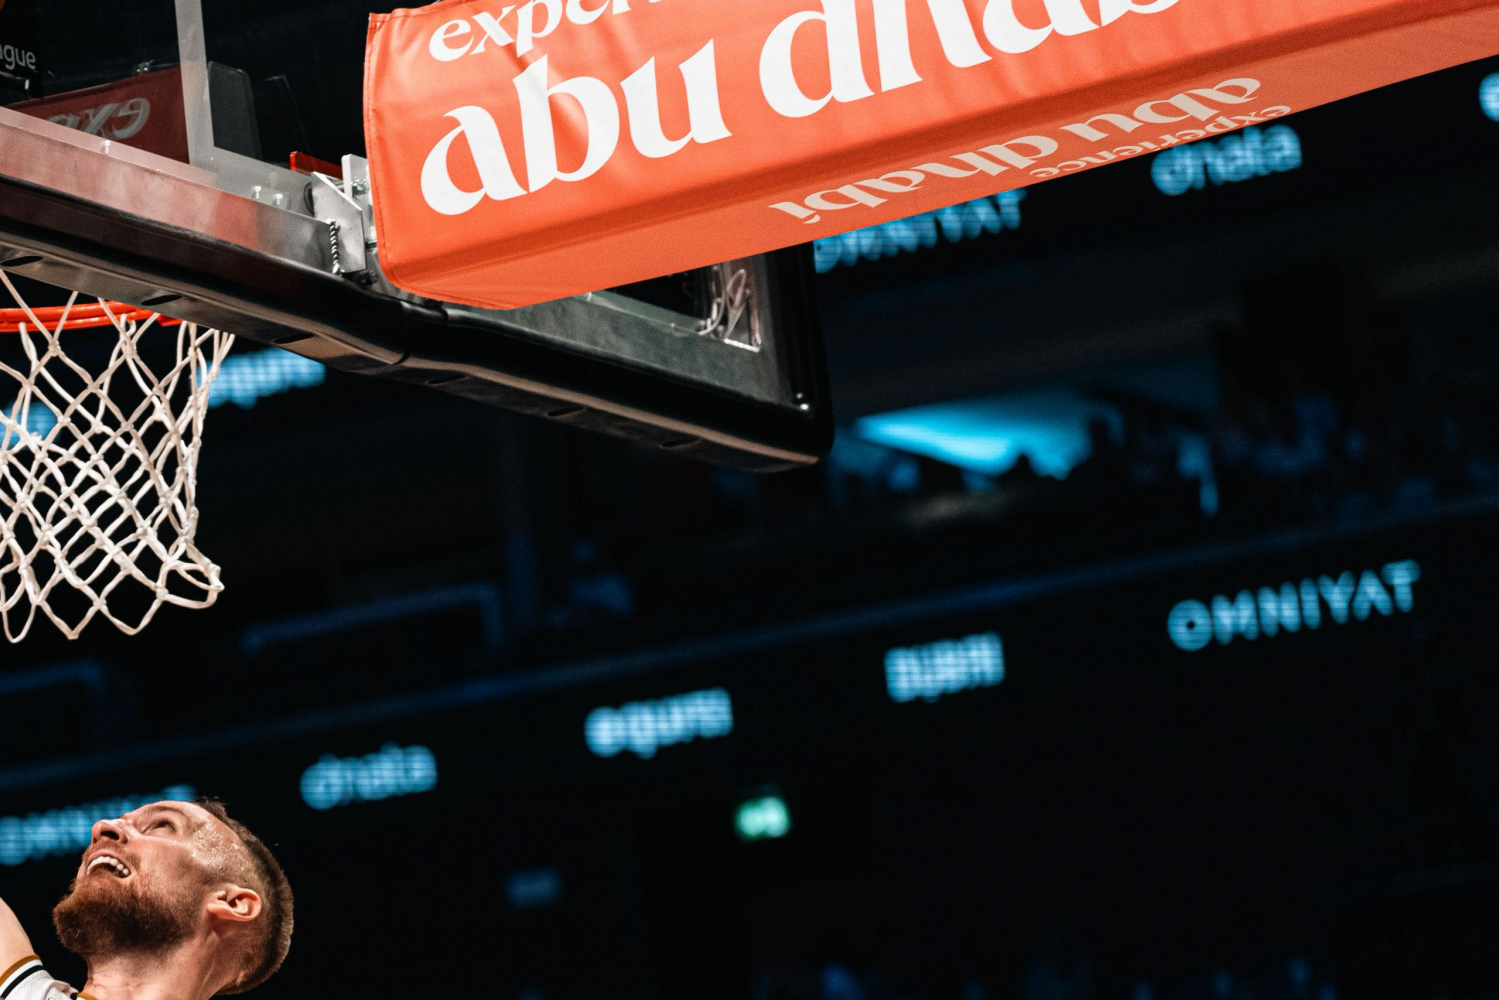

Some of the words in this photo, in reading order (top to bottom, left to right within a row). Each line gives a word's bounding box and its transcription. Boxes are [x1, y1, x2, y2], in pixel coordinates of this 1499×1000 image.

[421, 38, 732, 215] abu
[1029, 105, 1292, 178] experience
[1058, 77, 1262, 143] abu
[767, 134, 1059, 225] dhabi
[1167, 560, 1421, 651] OMNIYAT
